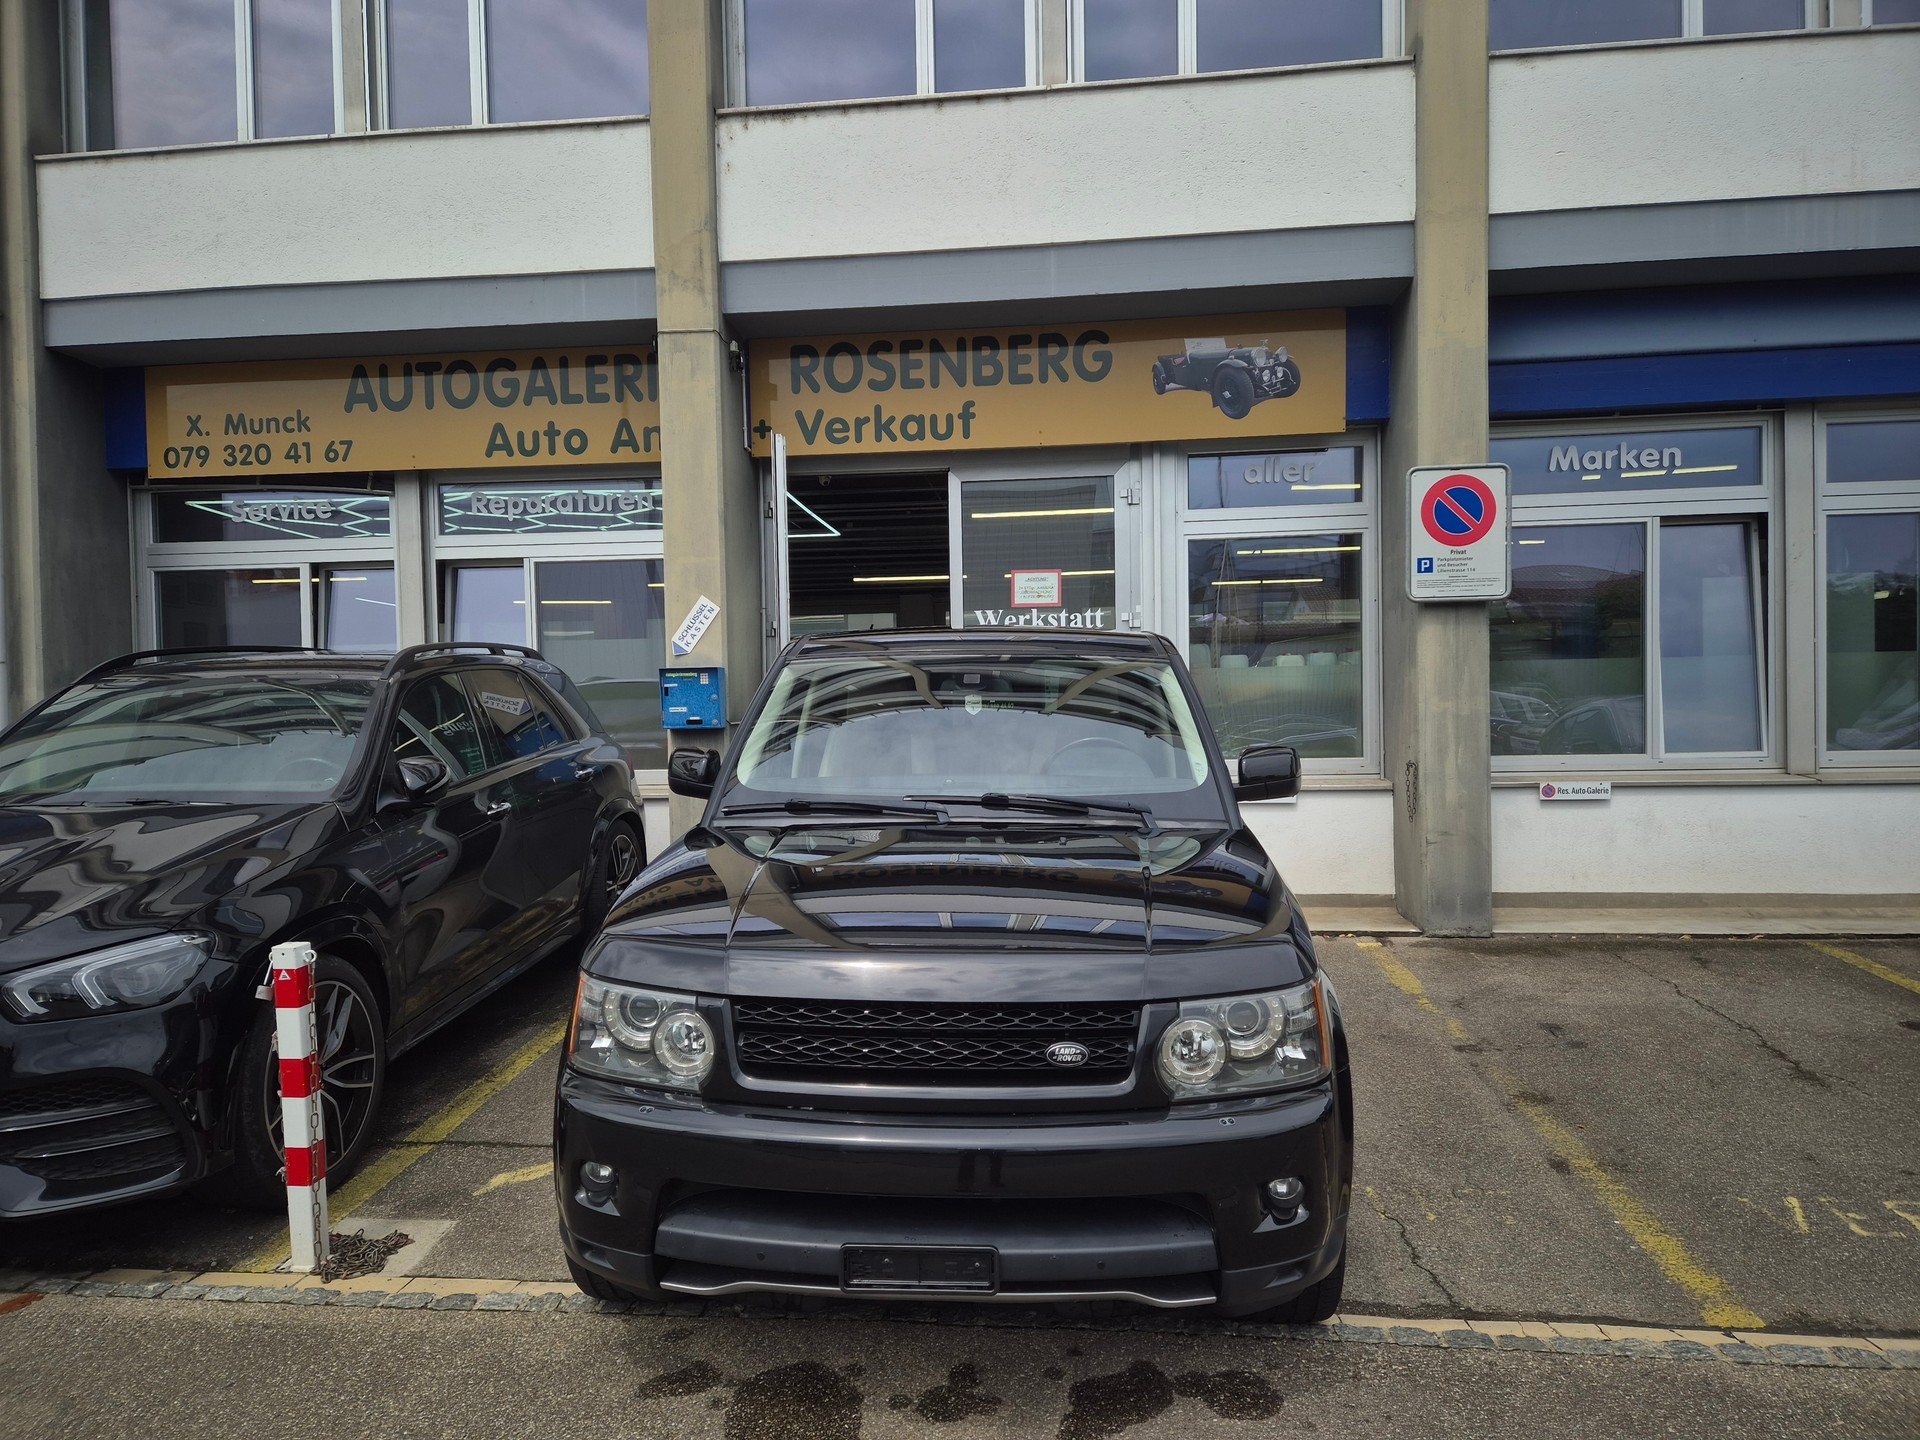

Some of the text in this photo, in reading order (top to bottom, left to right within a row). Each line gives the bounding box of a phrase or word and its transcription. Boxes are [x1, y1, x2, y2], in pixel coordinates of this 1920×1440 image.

[789, 329, 1114, 395] ROSENBERG
[186, 409, 311, 438] X. Munck
[794, 400, 976, 446] Verkauf
[162, 439, 354, 470] 079 320 41 67
[484, 419, 589, 459] Auto
[1243, 456, 1316, 484] aller
[1548, 441, 1683, 472] Marken
[230, 498, 333, 523] Service
[471, 489, 654, 521] Reparaturen
[678, 603, 709, 642] SCHLÜSSEL
[684, 606, 715, 647] KASTEN
[974, 607, 1105, 629] Werkstatt
[1557, 786, 1610, 794] Res. Auto-Galerie
[1055, 1047, 1076, 1055] LAND
